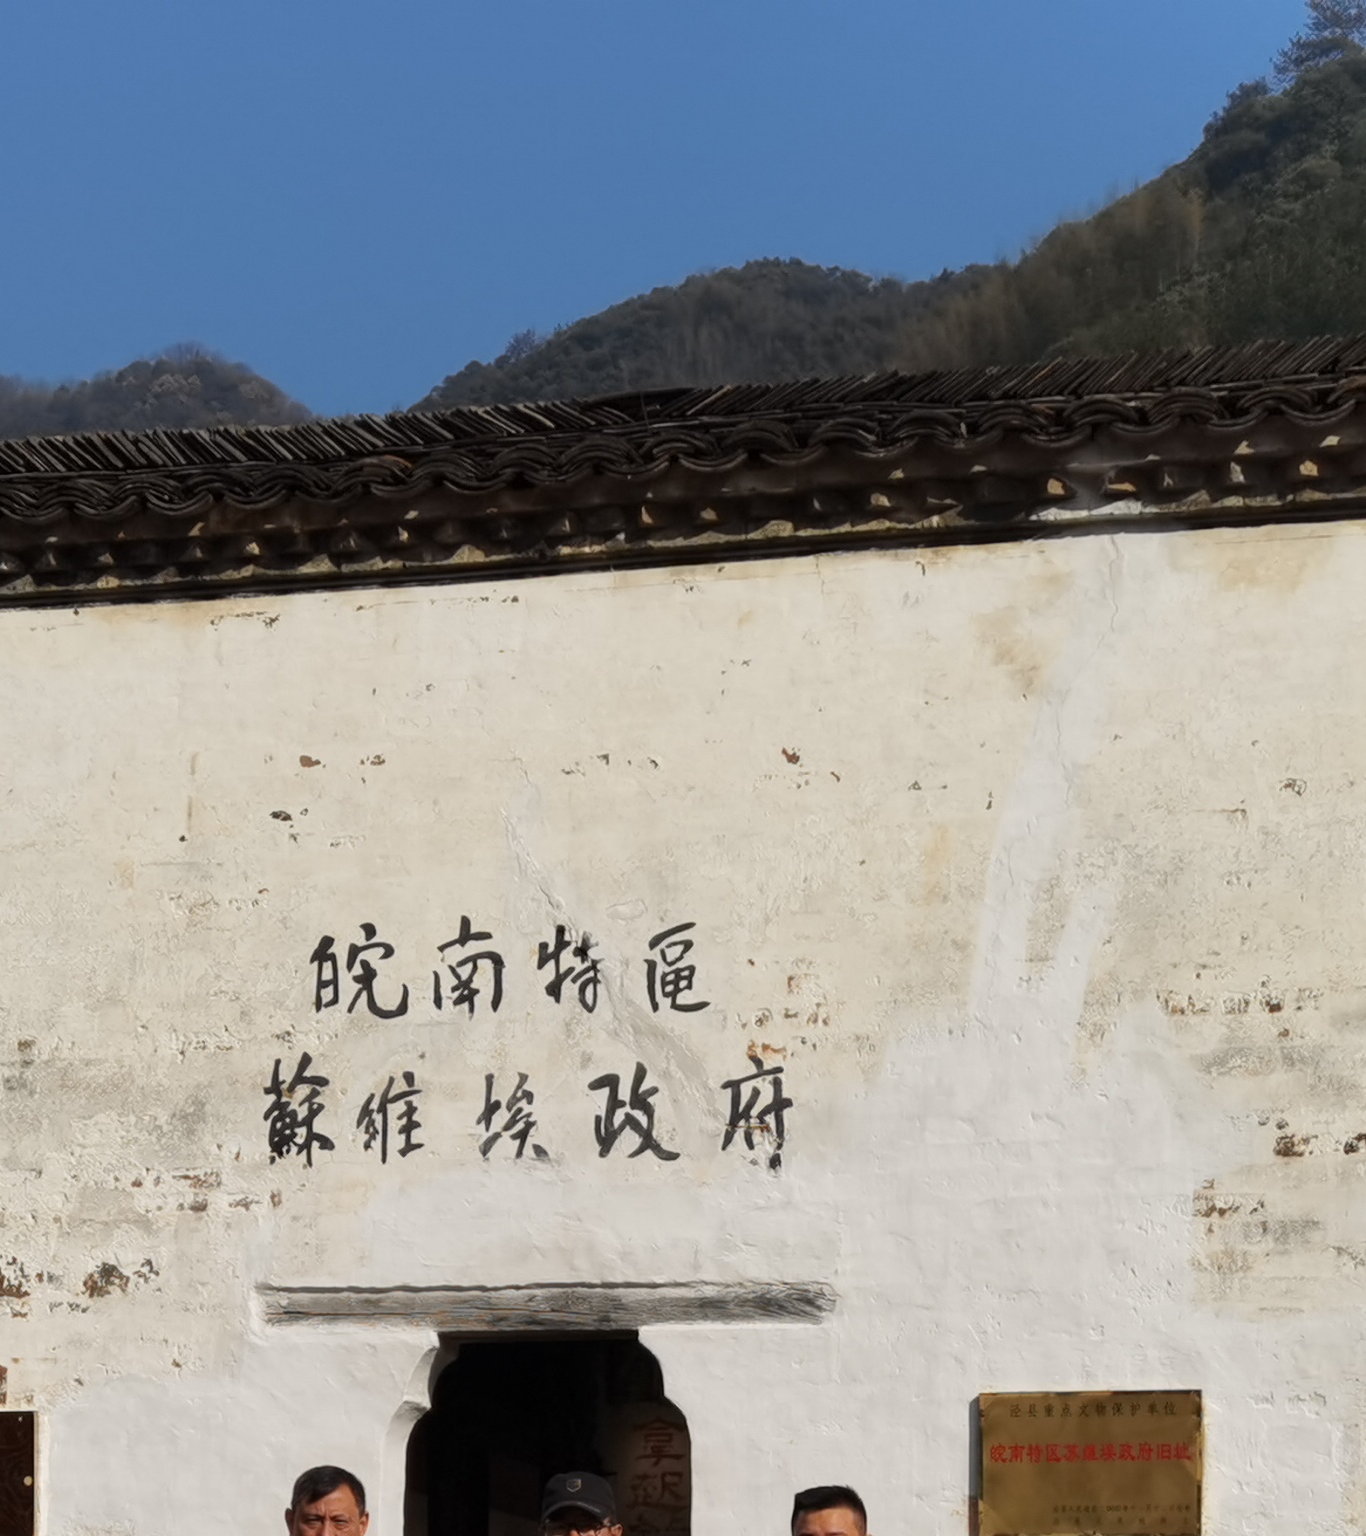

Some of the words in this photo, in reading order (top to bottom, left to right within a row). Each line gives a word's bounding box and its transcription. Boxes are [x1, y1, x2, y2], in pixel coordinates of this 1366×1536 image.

[989, 1441, 1195, 1463] 皖南特区苏维埃政府旧址
